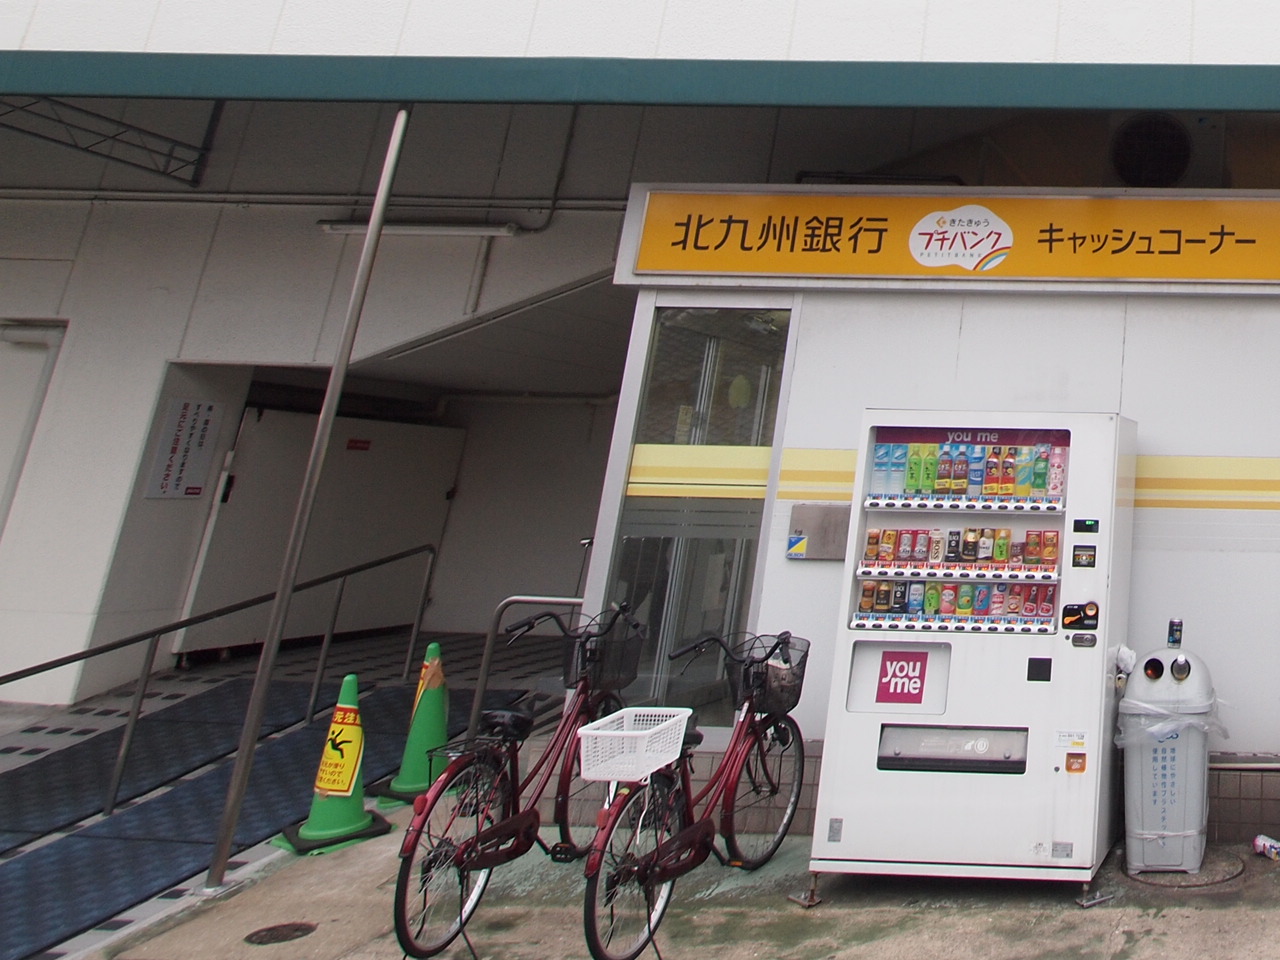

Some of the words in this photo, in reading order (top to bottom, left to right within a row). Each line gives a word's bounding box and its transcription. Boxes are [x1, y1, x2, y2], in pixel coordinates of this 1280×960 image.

[949, 218, 990, 228] きたきゅう
[671, 213, 889, 255] 北九州銀行
[918, 230, 1002, 251] プチバンク
[1036, 223, 1257, 256] キャッシュコーナー
[945, 431, 972, 444] you
[977, 432, 999, 442] me
[882, 661, 921, 683] you
[889, 677, 921, 694] me
